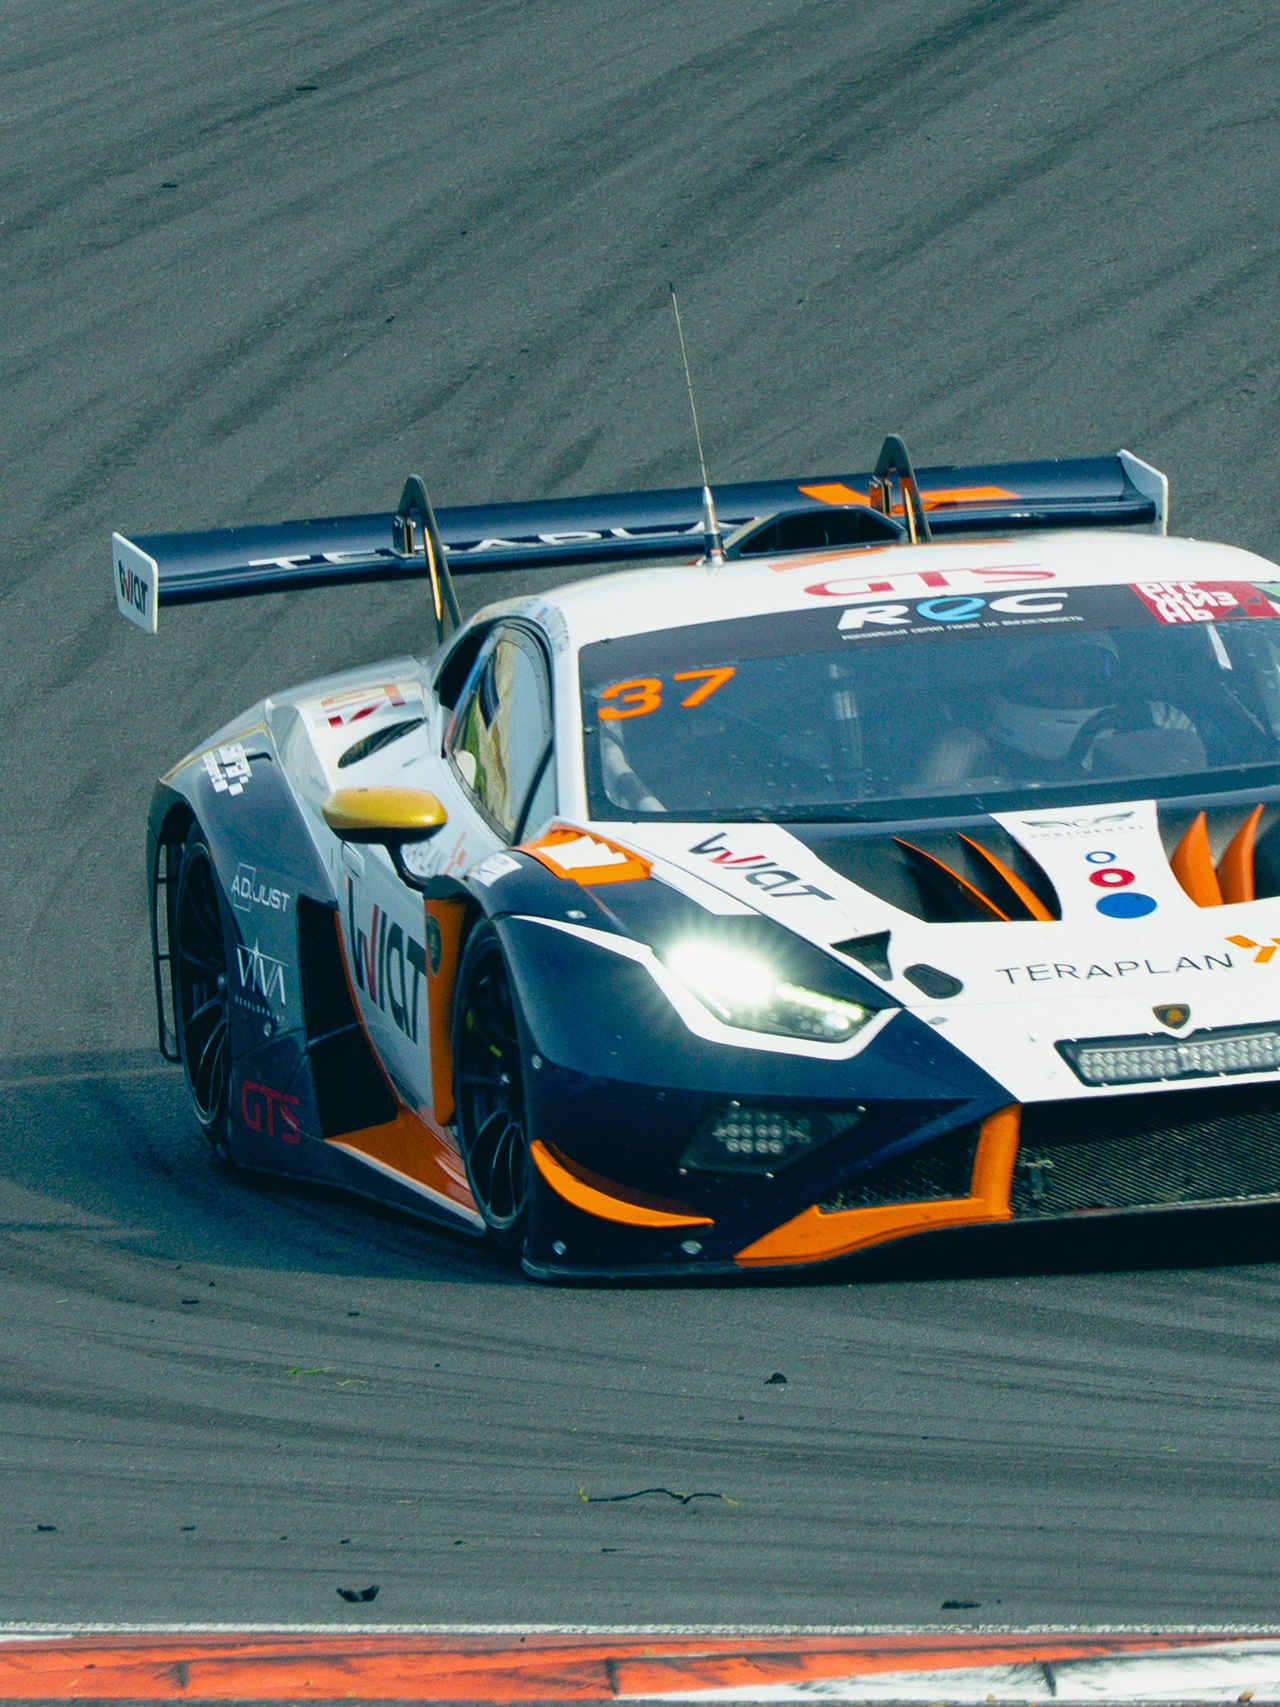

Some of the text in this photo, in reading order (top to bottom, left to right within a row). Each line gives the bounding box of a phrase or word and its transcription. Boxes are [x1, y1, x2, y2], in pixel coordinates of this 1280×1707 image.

[803, 563, 1057, 597] GTS
[597, 666, 736, 721] 37
[995, 952, 1235, 986] TERAPLAN
[241, 1080, 301, 1145] GTS
